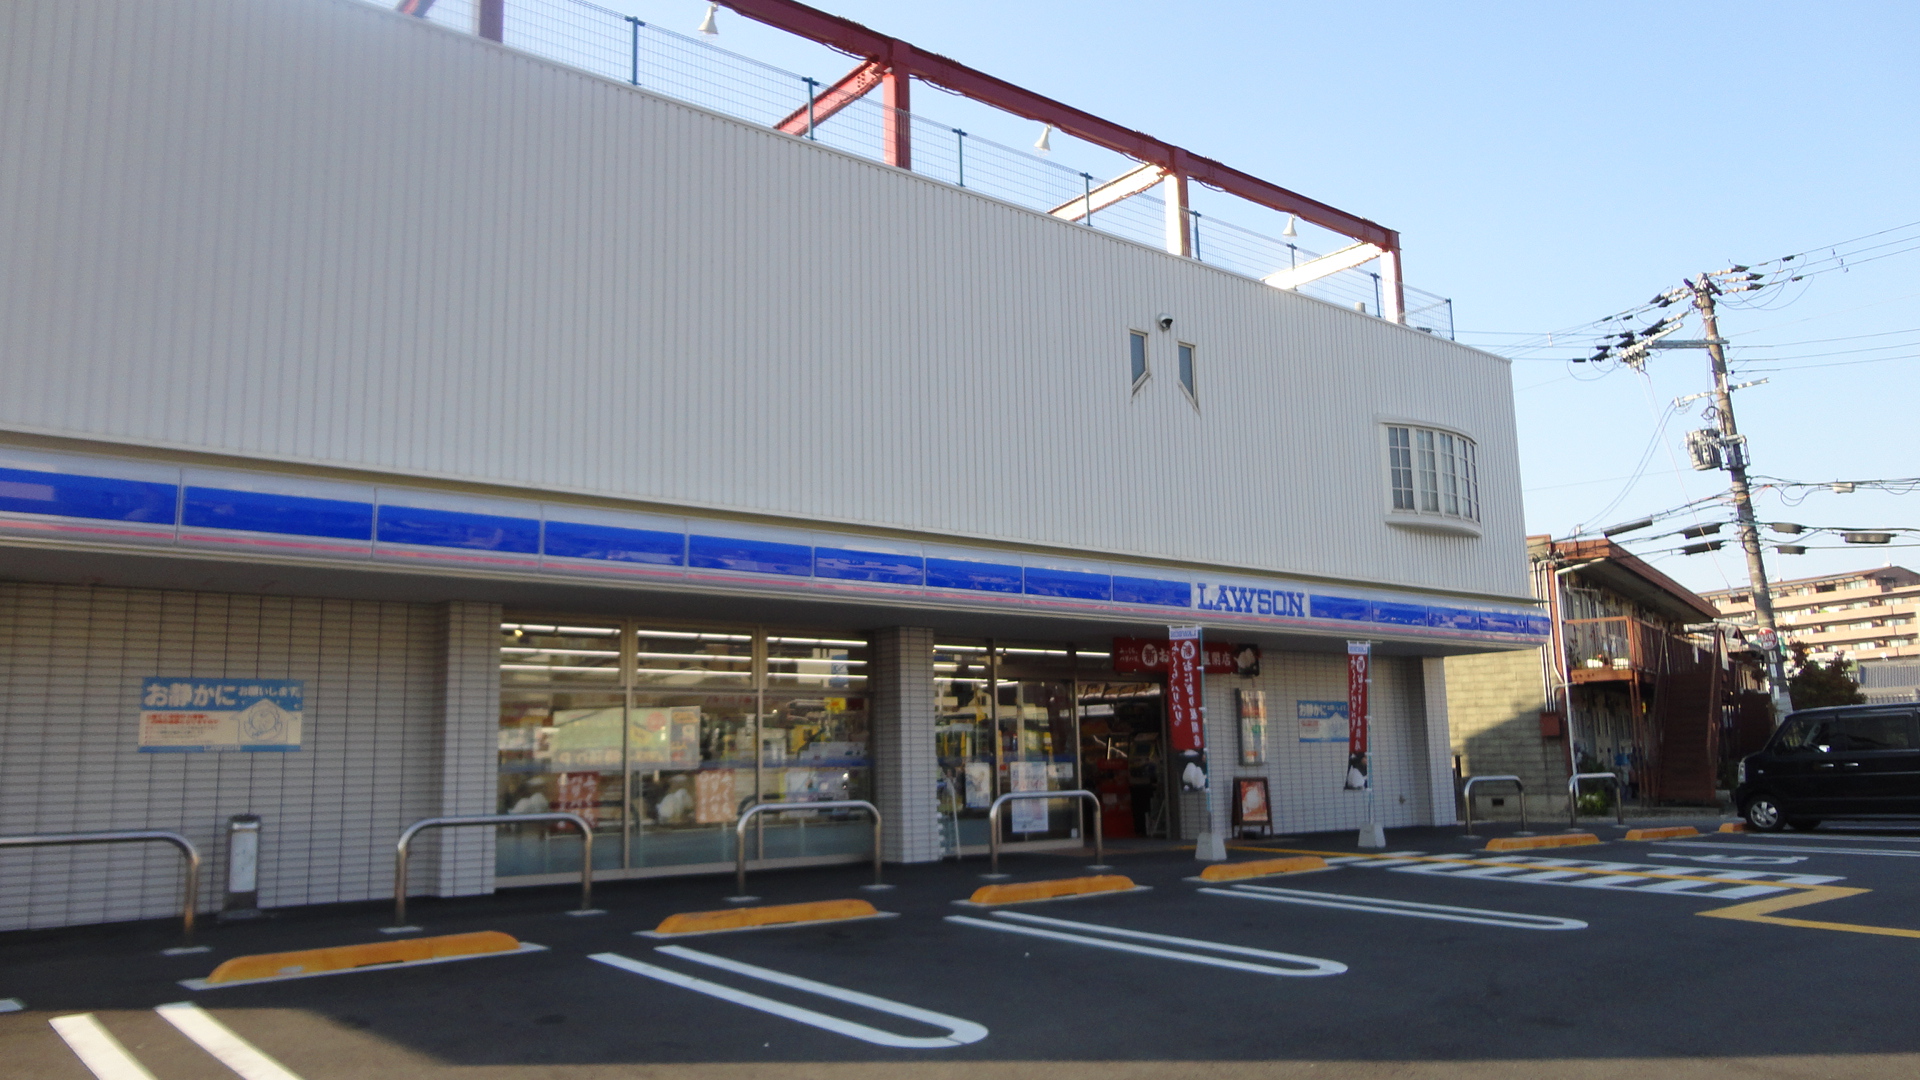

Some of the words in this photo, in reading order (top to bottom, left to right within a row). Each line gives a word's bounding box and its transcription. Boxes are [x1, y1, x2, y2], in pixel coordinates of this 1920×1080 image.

[1197, 583, 1305, 617] LAWSON
[144, 683, 235, 706] お静かに
